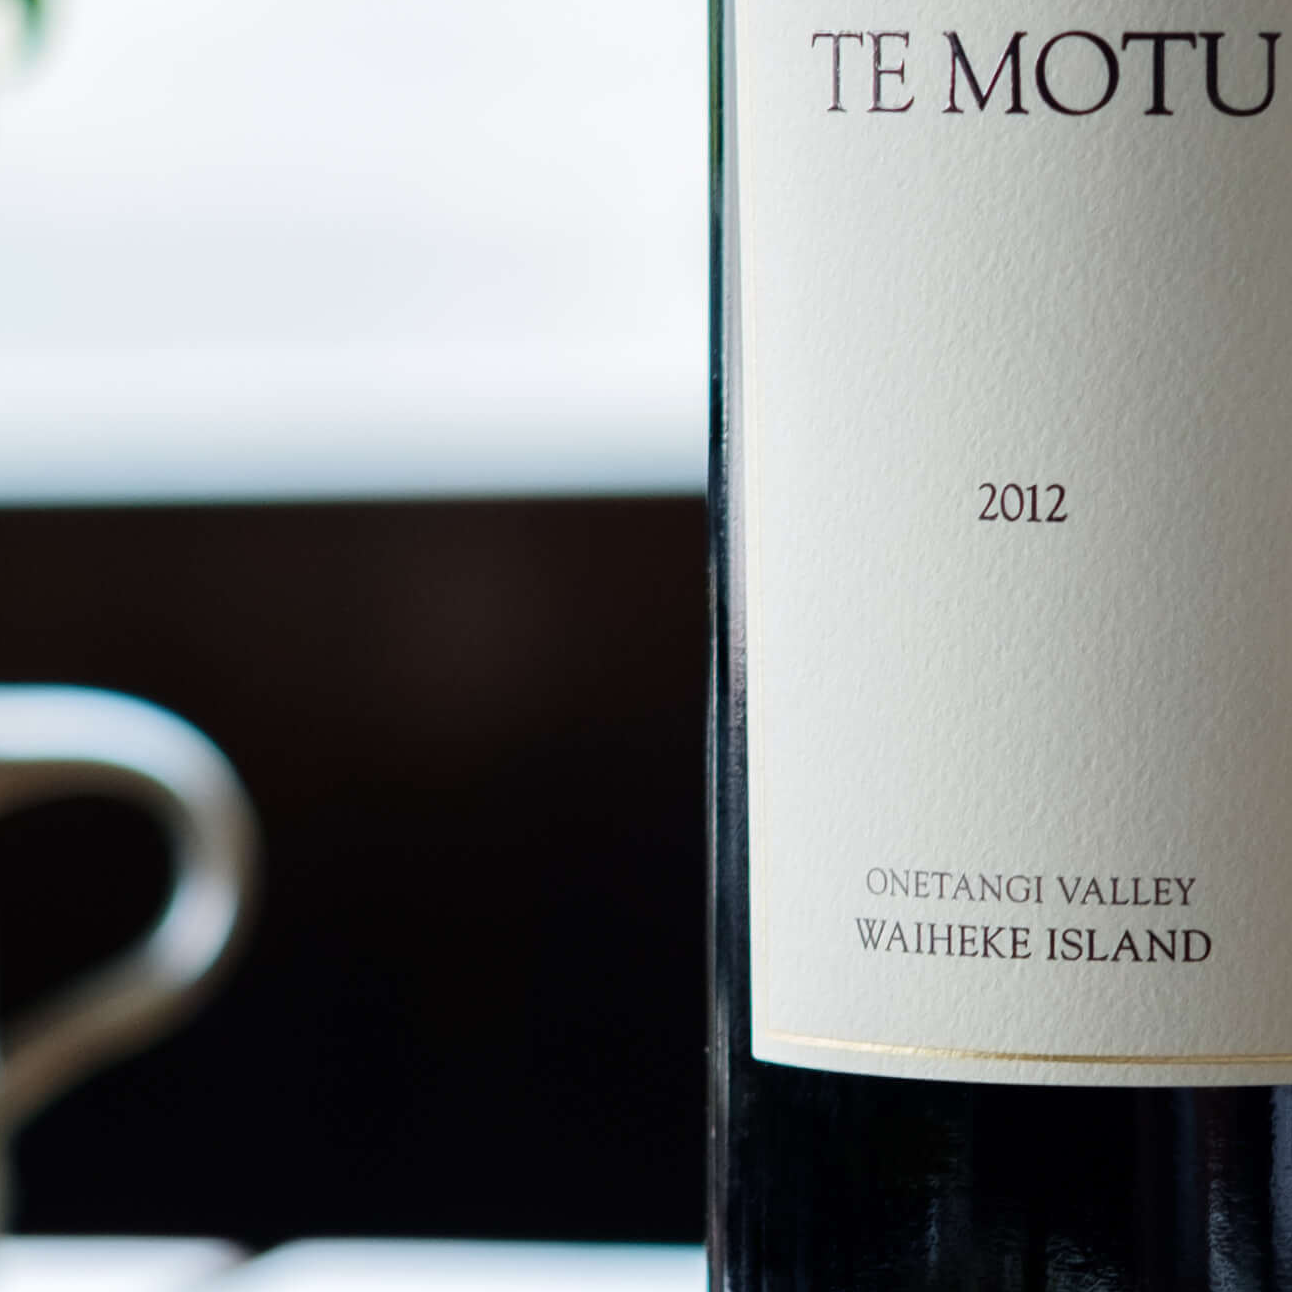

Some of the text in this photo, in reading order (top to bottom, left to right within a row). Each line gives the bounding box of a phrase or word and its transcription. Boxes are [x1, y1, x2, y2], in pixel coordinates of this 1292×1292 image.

[810, 29, 1282, 117] TE MOTU
[977, 482, 1069, 523] 2012
[865, 867, 1197, 907] ONETANGI VALLEY
[855, 917, 1213, 964] WAIHEKE ISLAND
